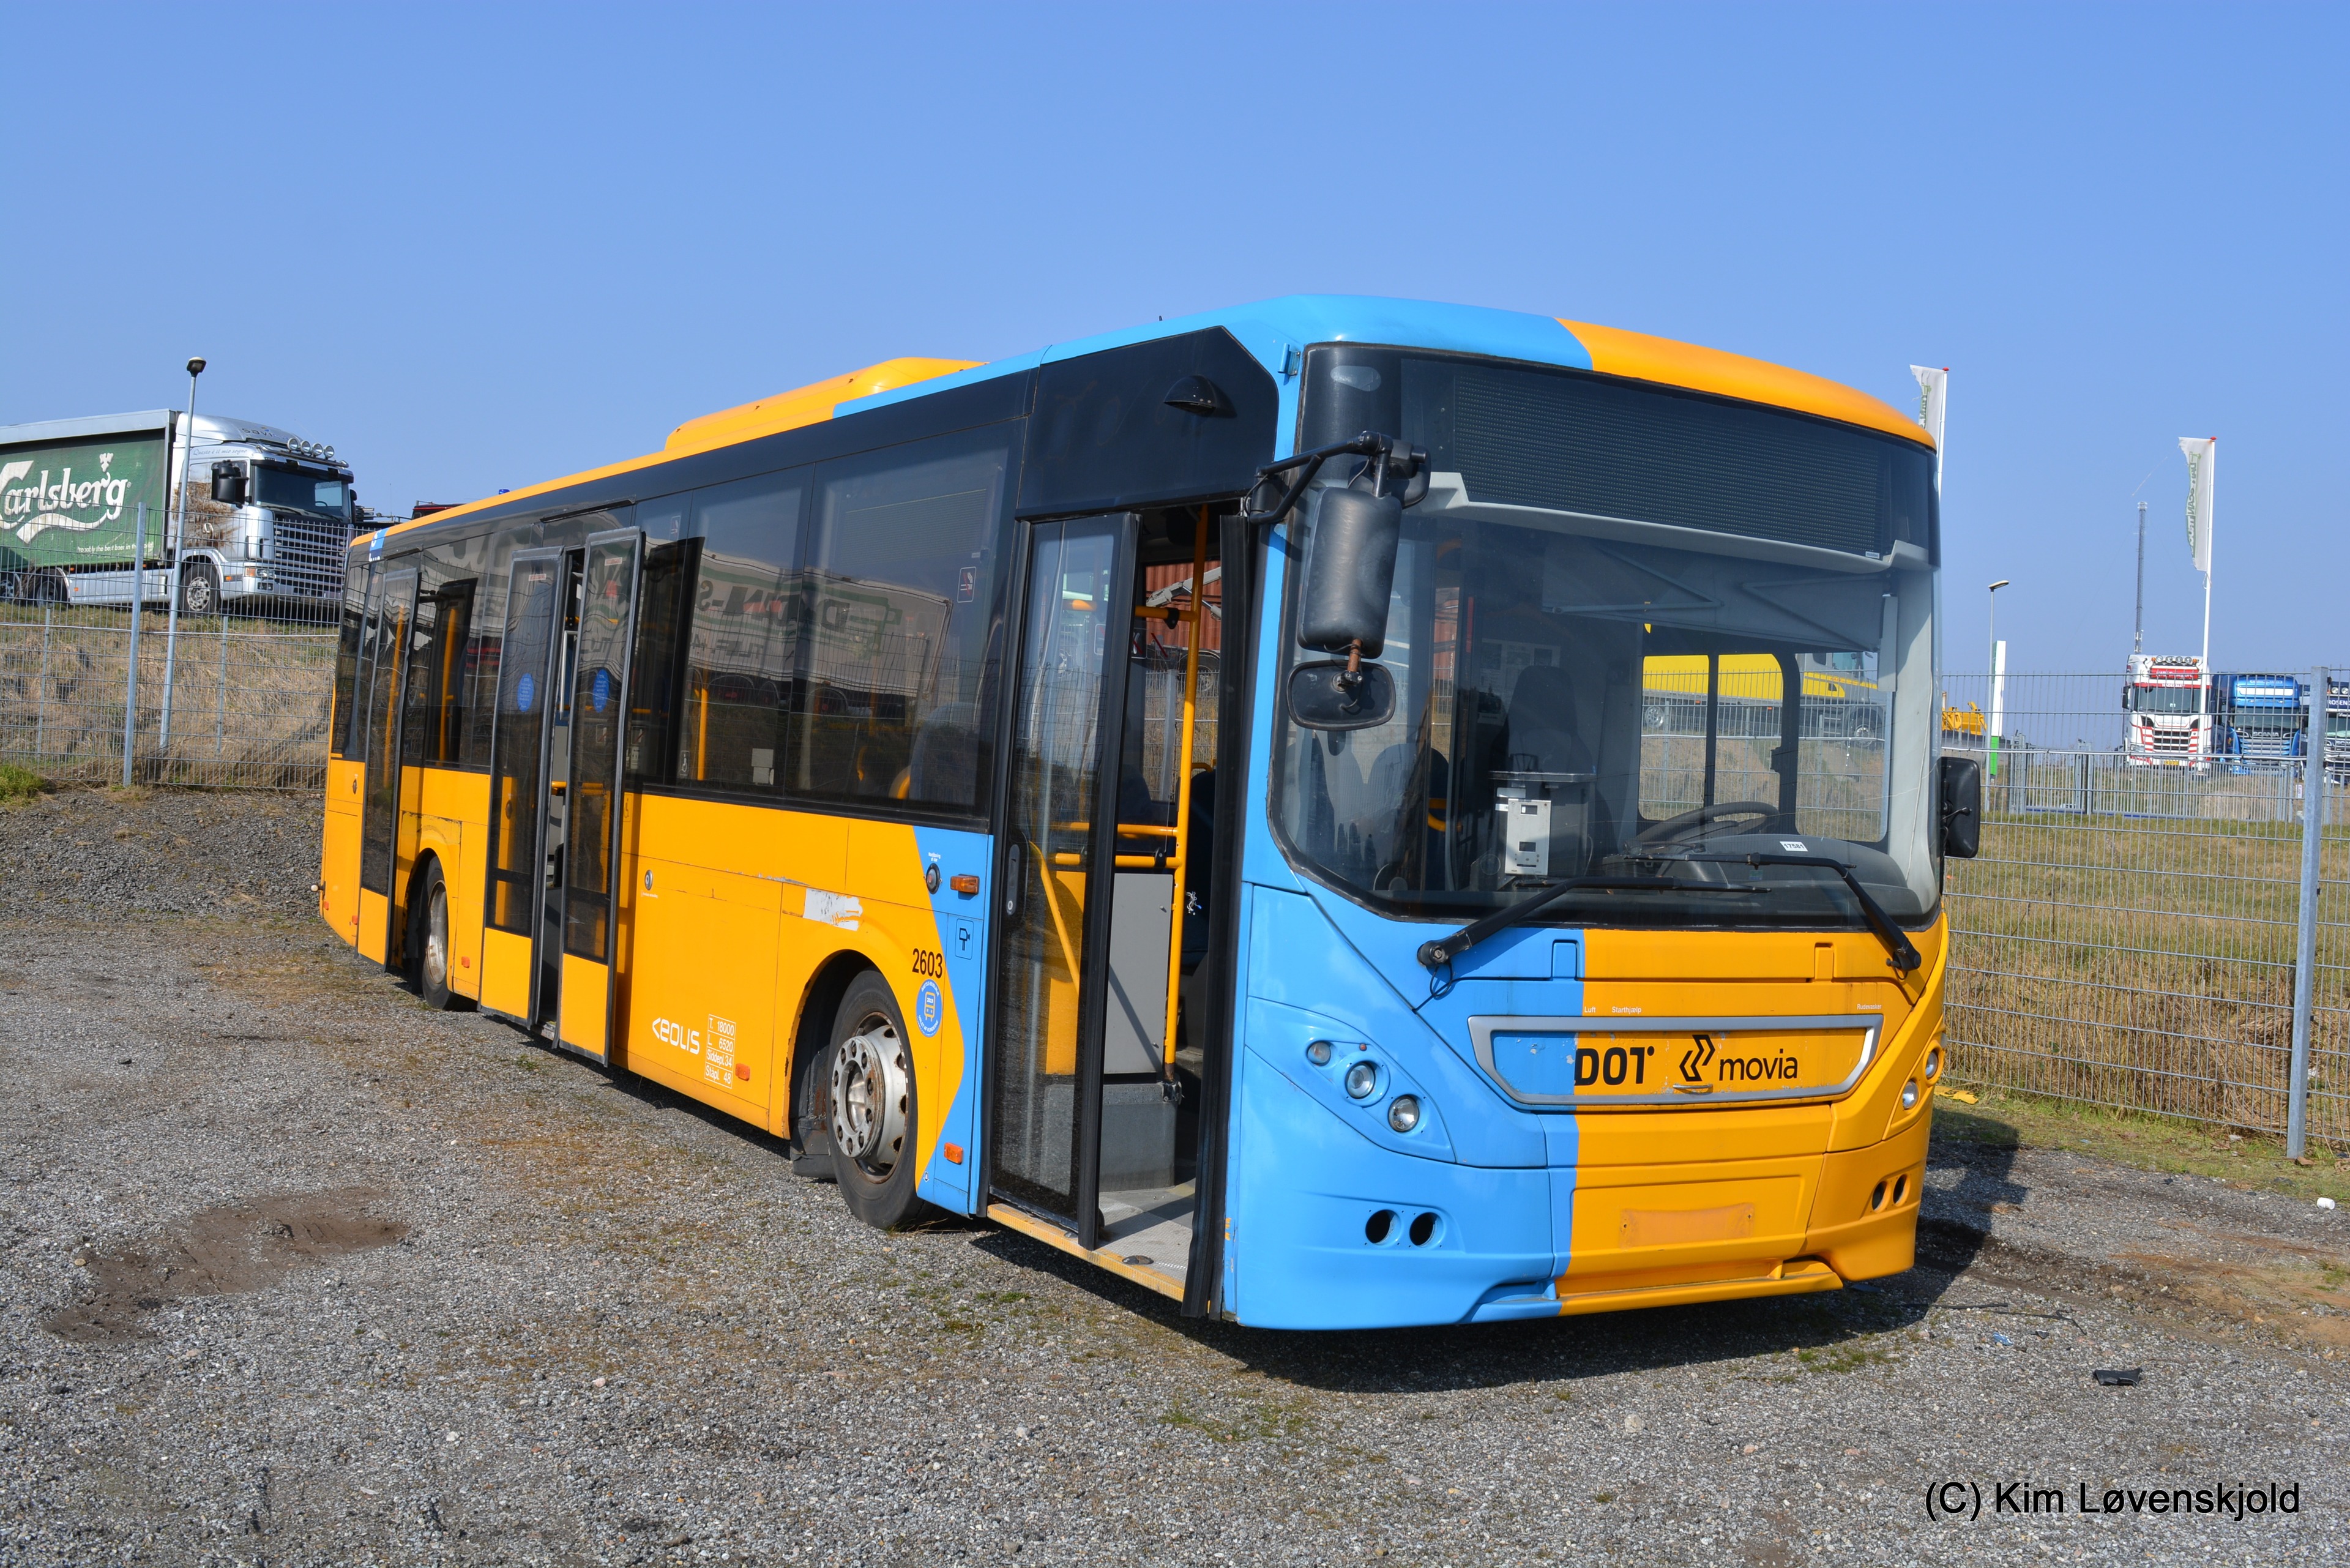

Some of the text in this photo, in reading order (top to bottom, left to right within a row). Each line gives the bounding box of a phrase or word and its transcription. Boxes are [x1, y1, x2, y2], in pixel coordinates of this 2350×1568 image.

[0, 460, 129, 530] Carlsberg
[912, 948, 943, 979] 2603
[717, 1020, 734, 1036] 18000
[718, 1037, 733, 1053] 6520
[706, 1048, 733, 1068] Siddepl. 34
[1574, 1047, 1798, 1086] DOT movia
[723, 1072, 731, 1084] 48
